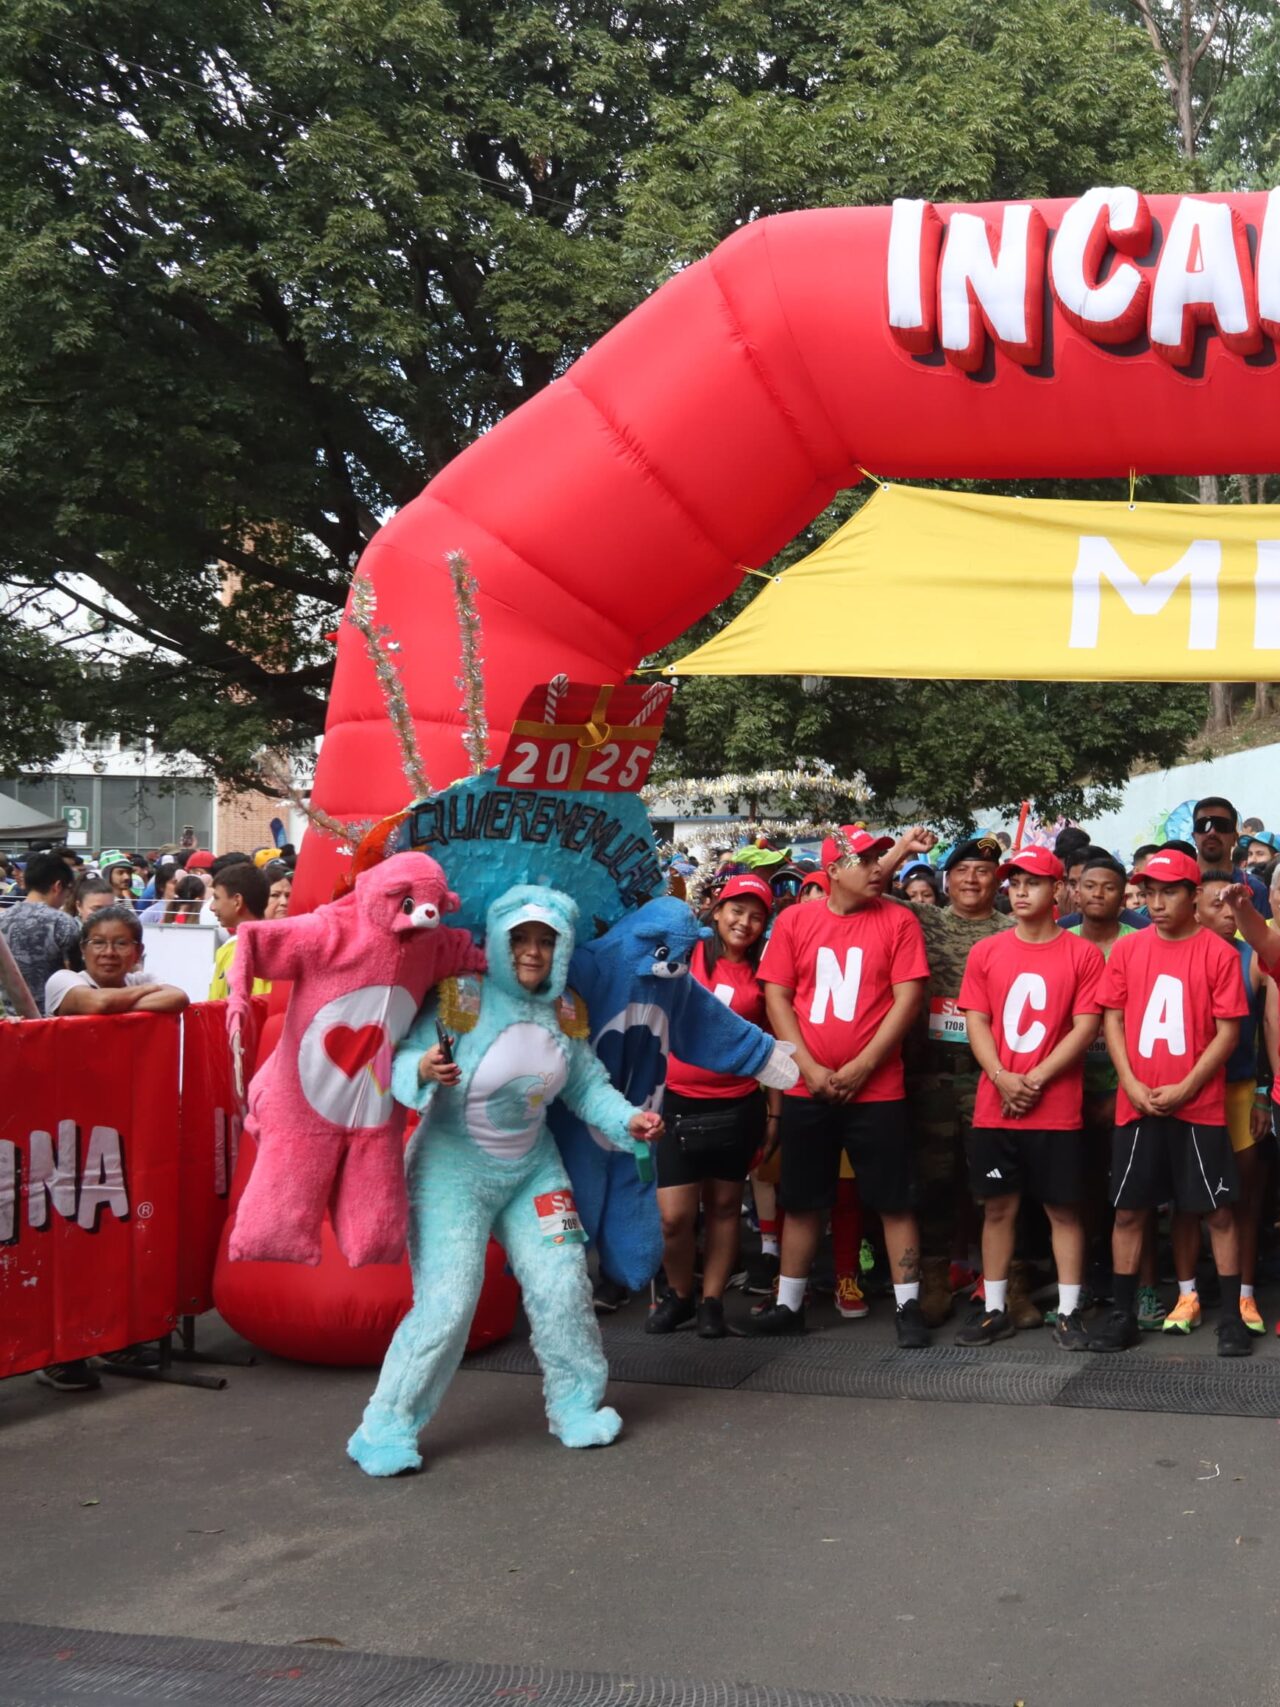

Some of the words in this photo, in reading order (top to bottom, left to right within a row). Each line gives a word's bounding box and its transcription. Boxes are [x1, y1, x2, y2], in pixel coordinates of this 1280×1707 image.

[507, 742, 650, 787] 2025
[68, 808, 82, 829] 3
[808, 946, 863, 1025] N
[1002, 972, 1047, 1054] C
[1138, 973, 1187, 1059] A
[944, 1020, 964, 1031] 1708
